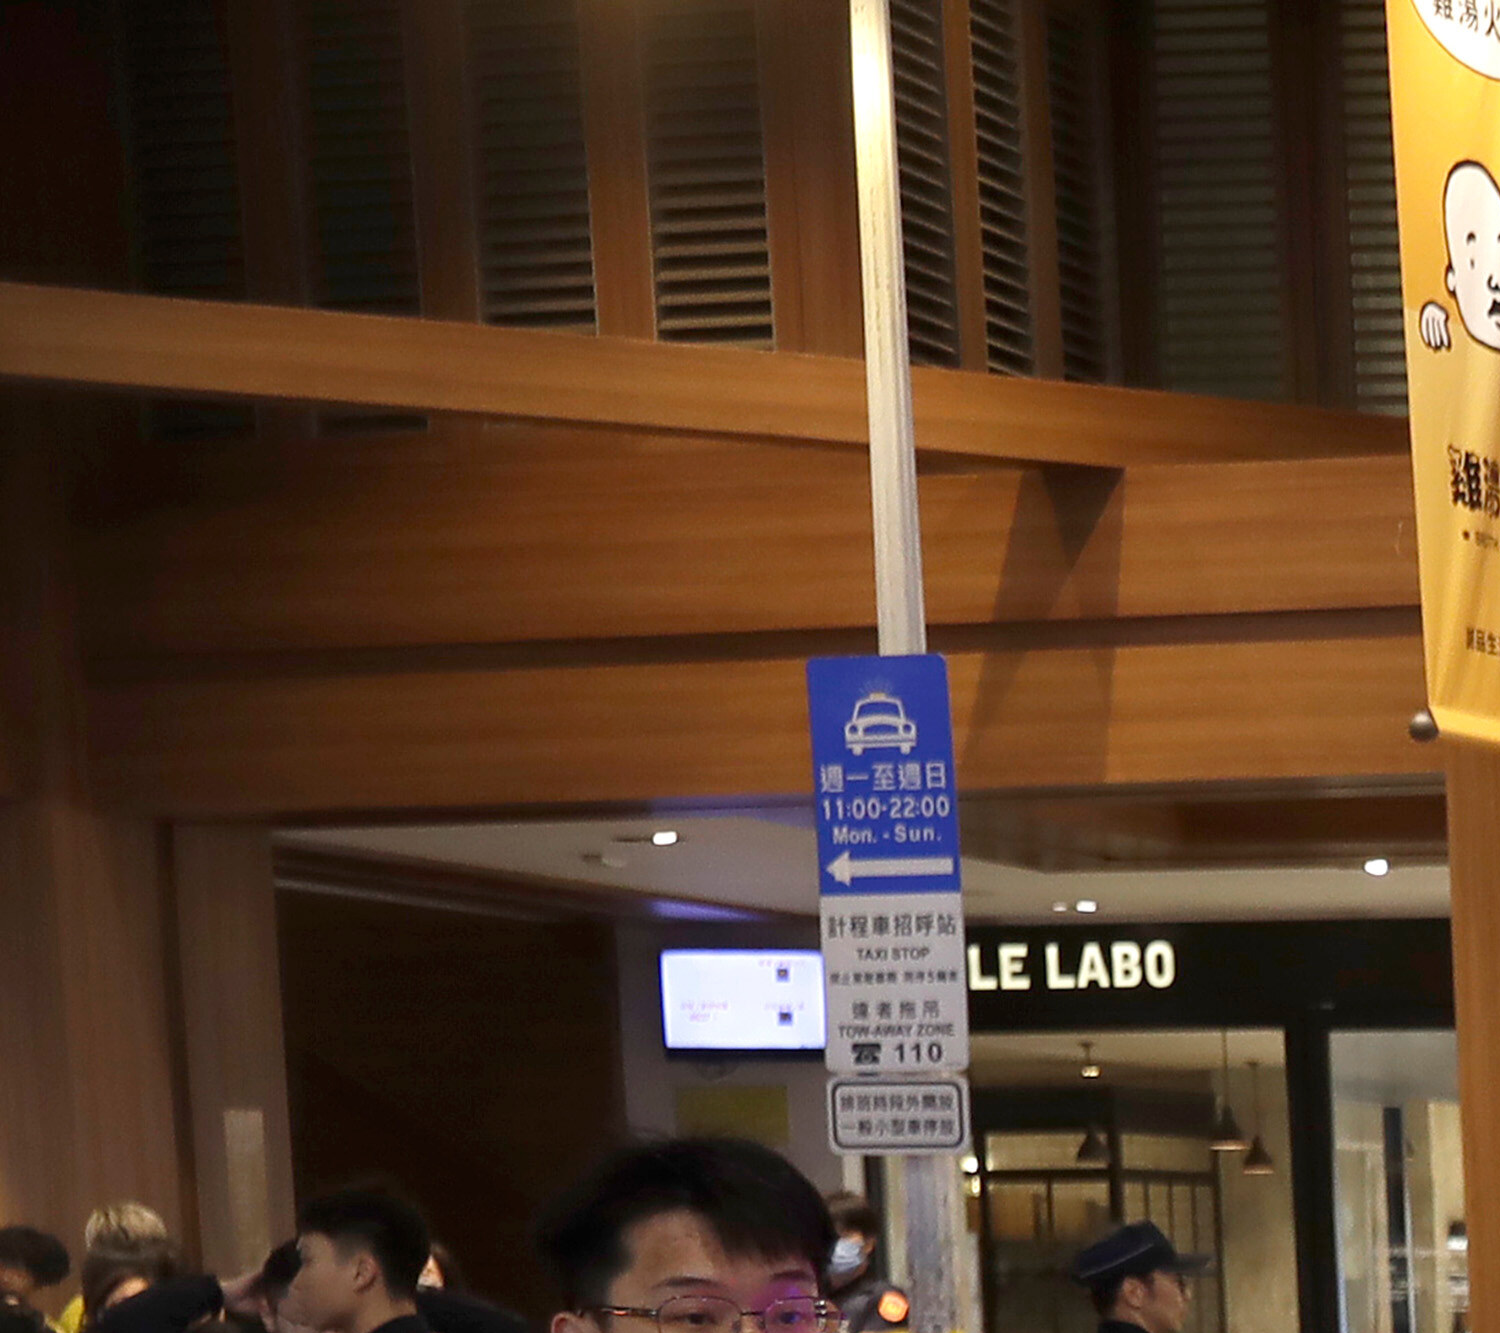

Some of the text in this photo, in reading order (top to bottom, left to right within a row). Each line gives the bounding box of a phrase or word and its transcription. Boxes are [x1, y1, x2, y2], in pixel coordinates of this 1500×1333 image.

[820, 761, 947, 793] 週一至週日
[832, 825, 878, 845] Mon.
[894, 823, 943, 844] Sun.
[828, 915, 956, 939] 計程車招呼站
[857, 948, 931, 962] TAXI STOP
[967, 939, 1177, 992] LE LABO
[852, 1001, 941, 1021] 違者拖吊
[916, 1022, 955, 1038] ZONE
[894, 1042, 944, 1063] 110
